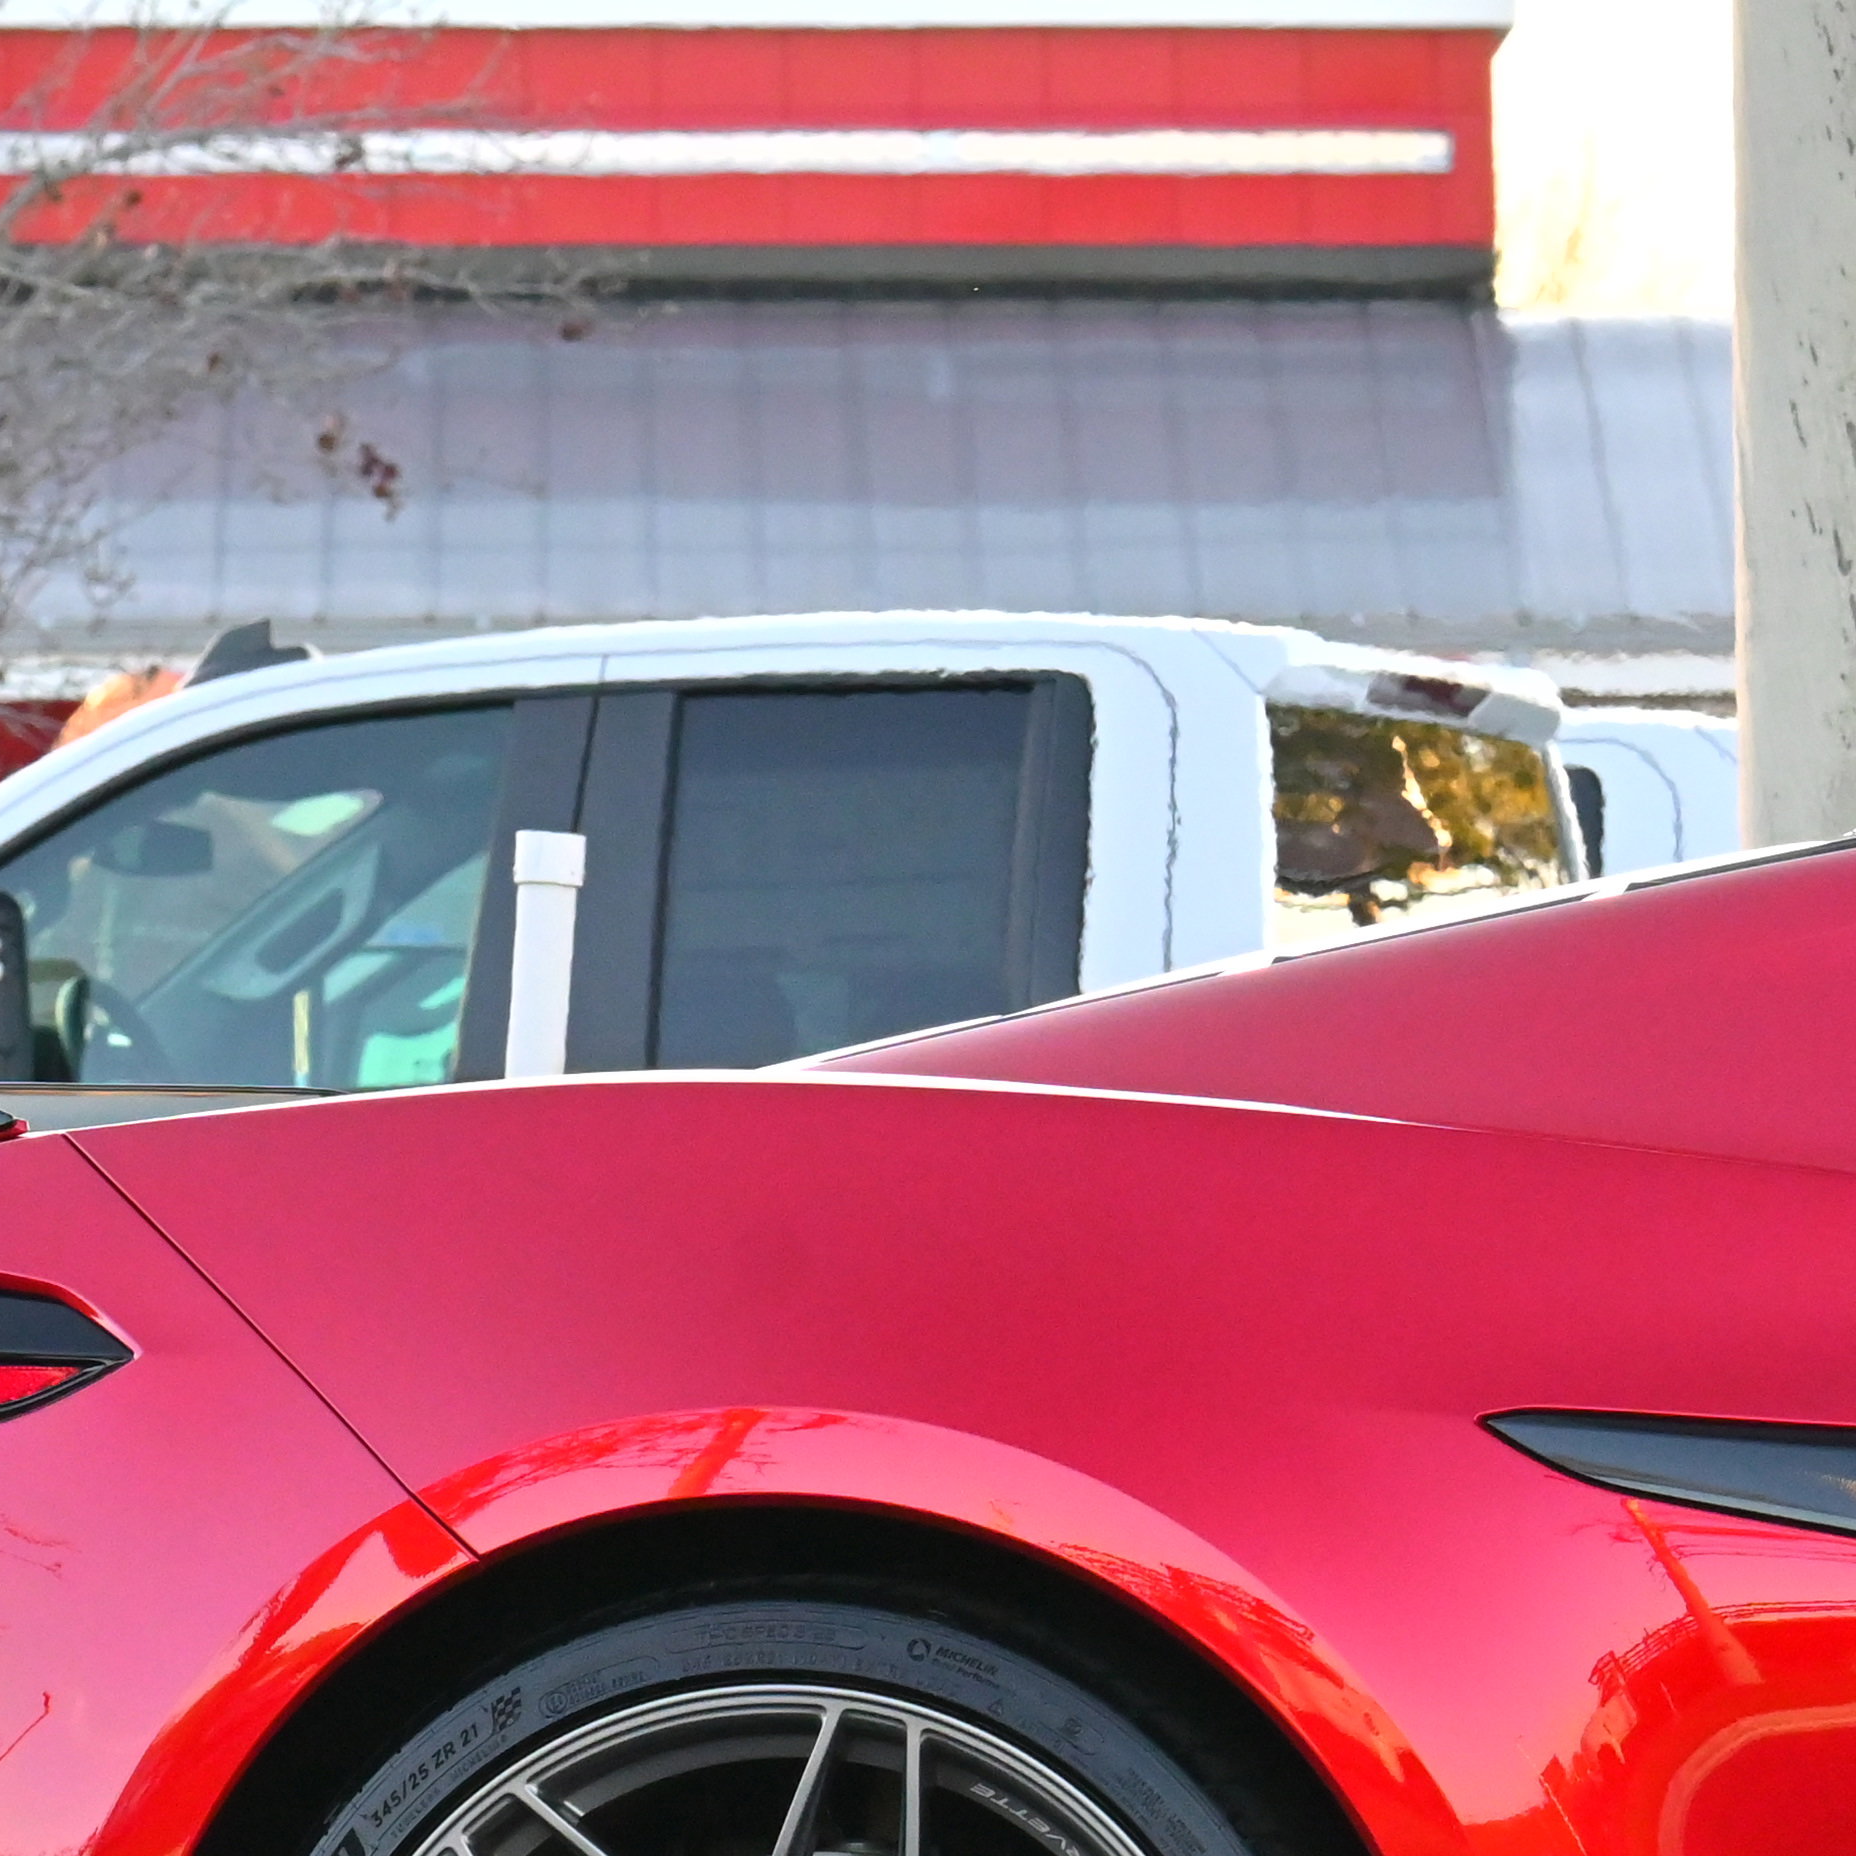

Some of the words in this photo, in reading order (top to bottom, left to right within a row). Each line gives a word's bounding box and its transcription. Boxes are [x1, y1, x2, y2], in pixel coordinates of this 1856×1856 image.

[934, 1644, 999, 1677] MICHELIN
[371, 1763, 429, 1828] 345/25
[431, 1741, 457, 1769] ZR
[459, 1723, 478, 1747] 21
